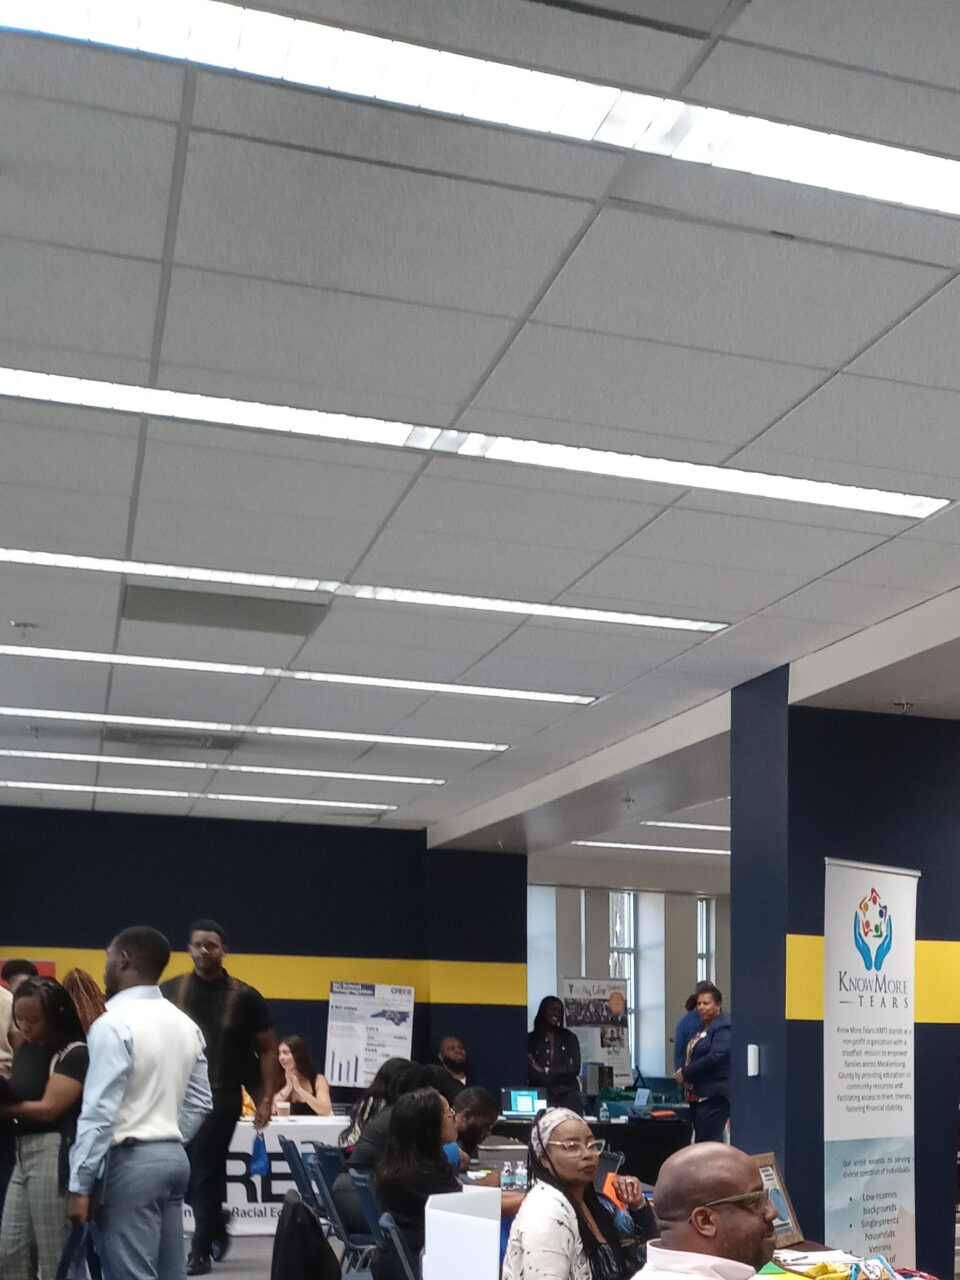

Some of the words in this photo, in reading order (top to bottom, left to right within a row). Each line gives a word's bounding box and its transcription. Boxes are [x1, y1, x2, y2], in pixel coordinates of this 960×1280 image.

[858, 995, 909, 1009] TEARS
[866, 1038, 892, 1047] organization
[838, 1071, 854, 1080] County
[861, 1071, 883, 1080] providing
[883, 1071, 904, 1079] education
[846, 1083, 872, 1091] community
[231, 1206, 267, 1219] Racial
[863, 1204, 897, 1216] backgrounds
[864, 1230, 896, 1241] households
[868, 1244, 892, 1253] Veterans
